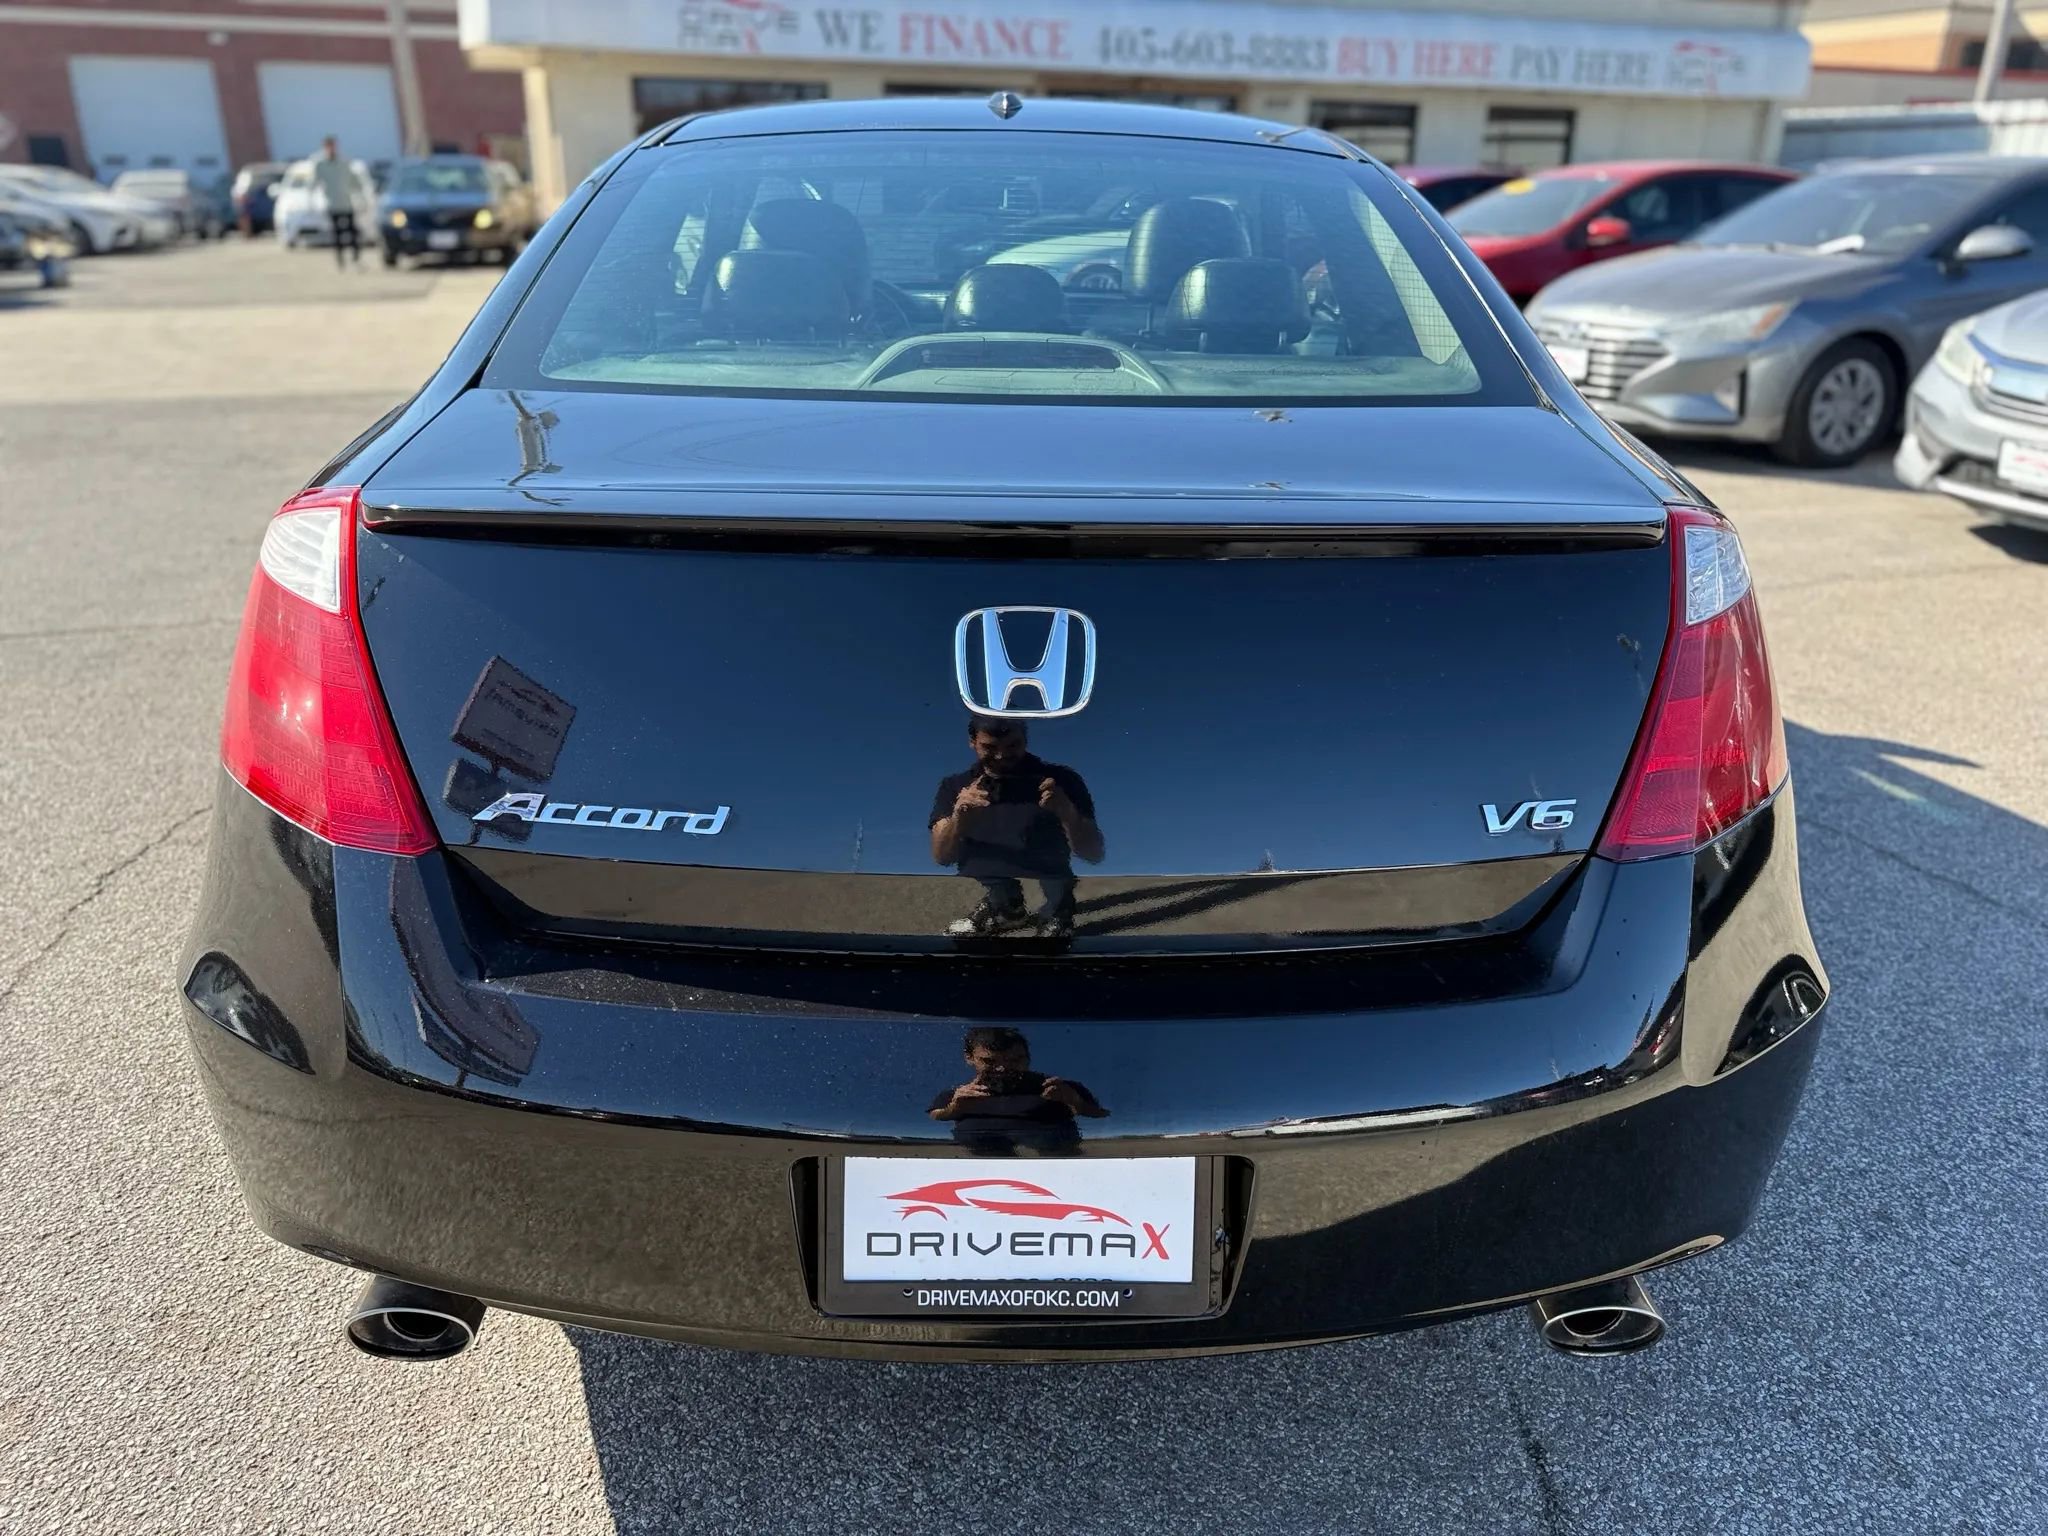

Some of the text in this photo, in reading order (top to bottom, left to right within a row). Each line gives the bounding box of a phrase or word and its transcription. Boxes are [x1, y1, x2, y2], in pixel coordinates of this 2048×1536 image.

[814, 9, 886, 53] WE
[899, 13, 1072, 59] FINANCE
[1336, 35, 1402, 76] BUY
[1411, 39, 1499, 80] HERE
[1509, 45, 1568, 81] PAY
[472, 792, 731, 835] Accord
[1481, 798, 1577, 835] V6
[866, 1222, 1171, 1261] DRIVEMAX
[917, 1288, 1120, 1309] DRIVEMAXOFOKC.COM
